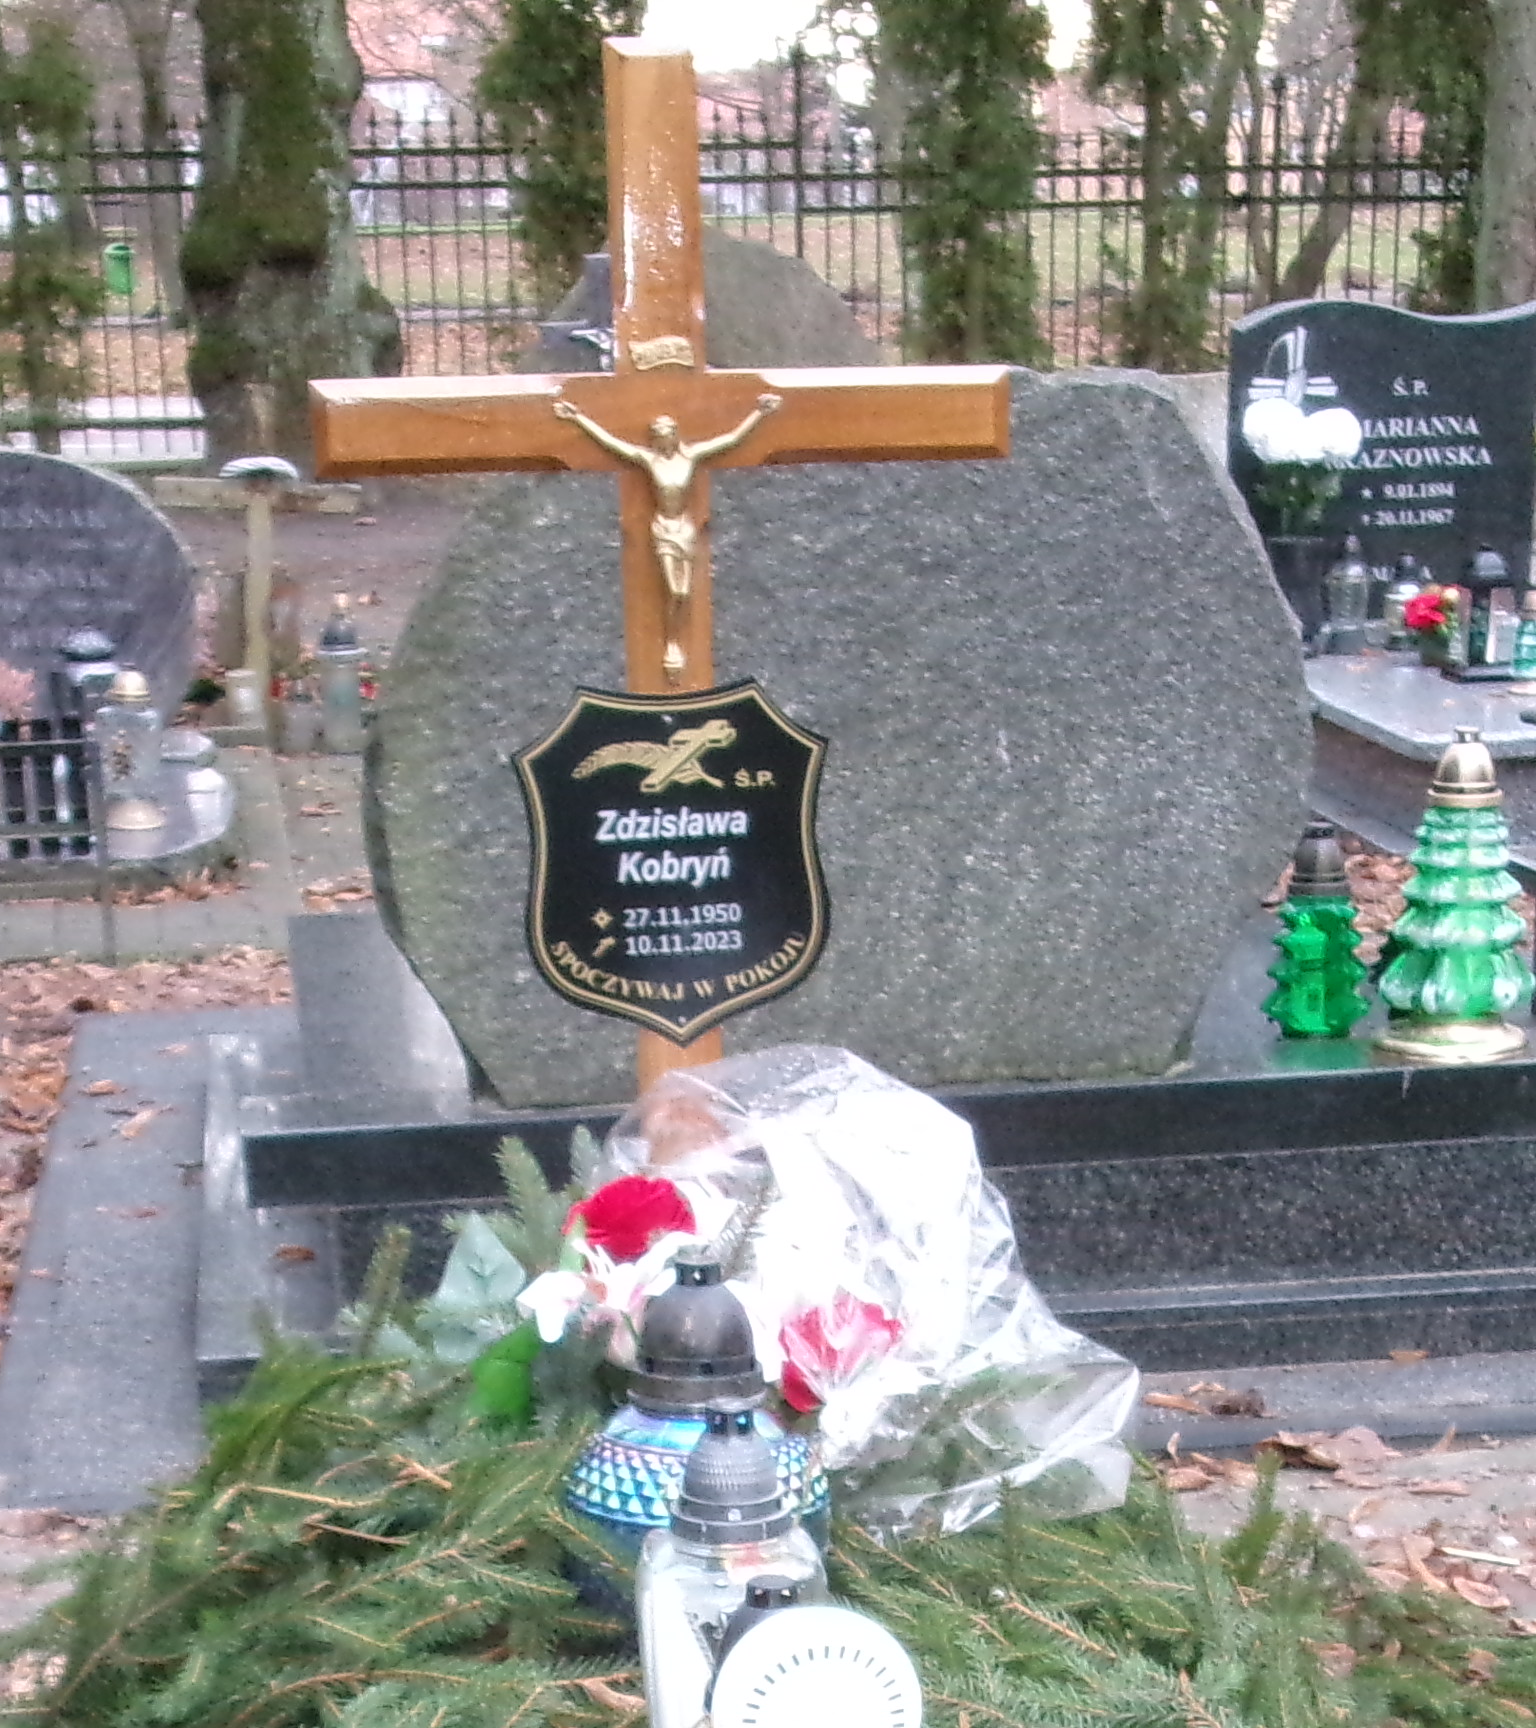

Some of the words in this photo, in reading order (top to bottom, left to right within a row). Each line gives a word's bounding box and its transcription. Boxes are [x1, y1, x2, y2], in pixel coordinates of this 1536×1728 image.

[734, 767, 776, 789] Ś.P.
[594, 805, 750, 843] Zdzisława
[616, 847, 732, 889] Kobryń
[622, 902, 743, 929] 27.11.1950
[624, 929, 743, 957] 10.11.2023
[550, 940, 686, 1001] SPOCZYWAJ
[693, 980, 716, 999] W
[724, 933, 807, 994] POKOJU
